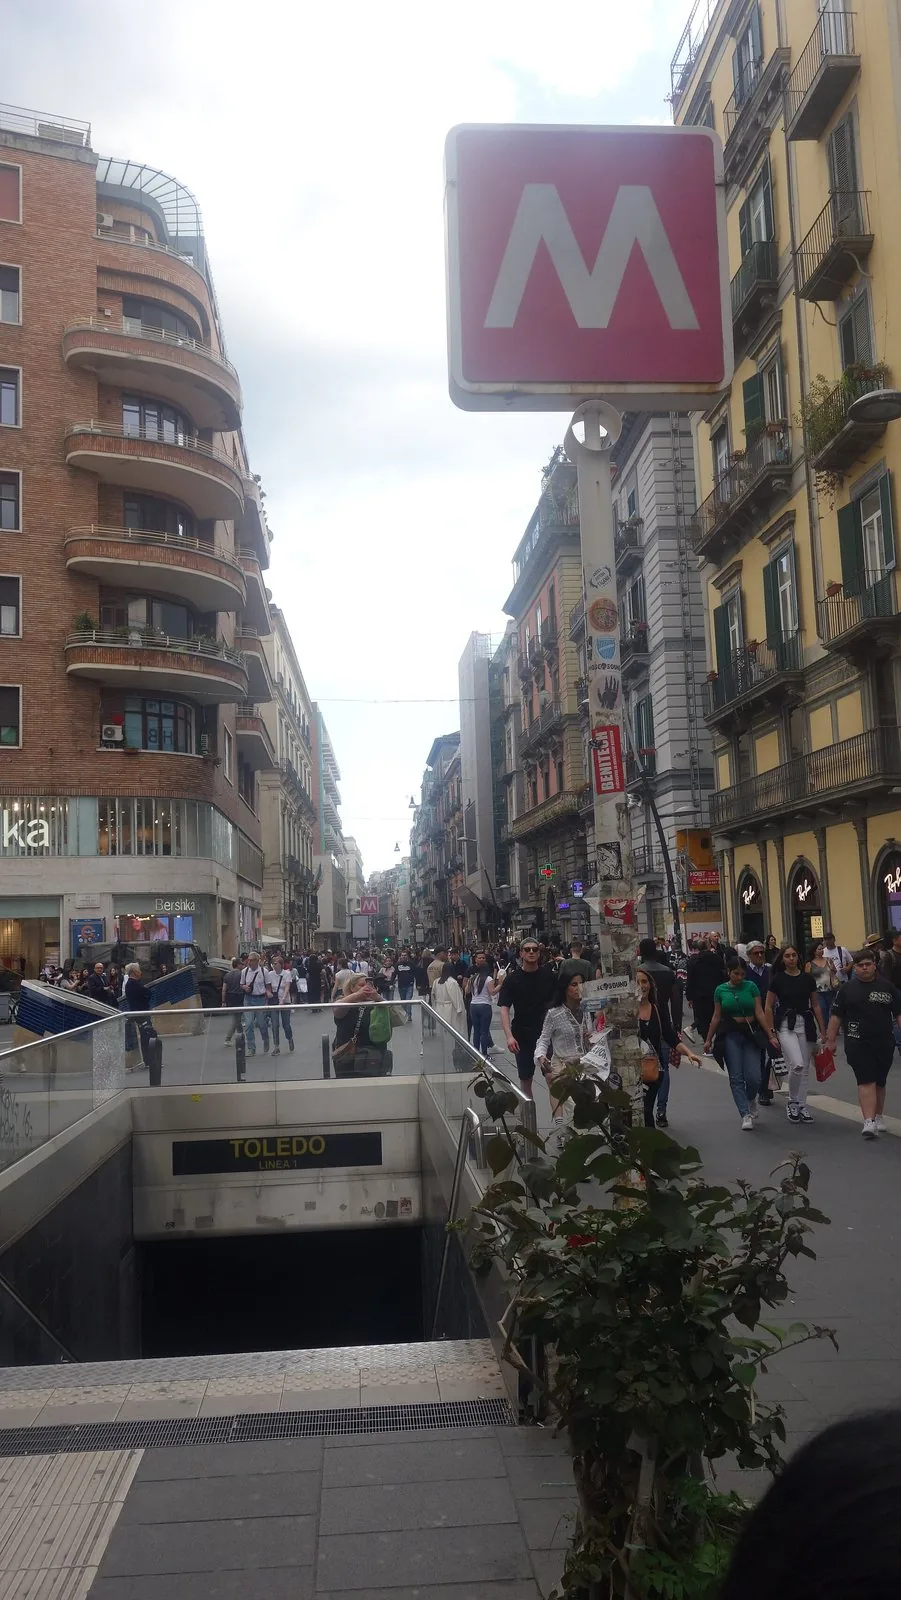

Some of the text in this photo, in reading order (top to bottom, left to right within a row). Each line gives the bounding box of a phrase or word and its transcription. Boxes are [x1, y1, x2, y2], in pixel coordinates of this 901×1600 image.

[483, 183, 701, 330] M
[3, 809, 50, 848] ka
[155, 898, 196, 911] Bershka
[230, 1135, 326, 1158] TOLEDO
[259, 1159, 297, 1170] LINEA 1
